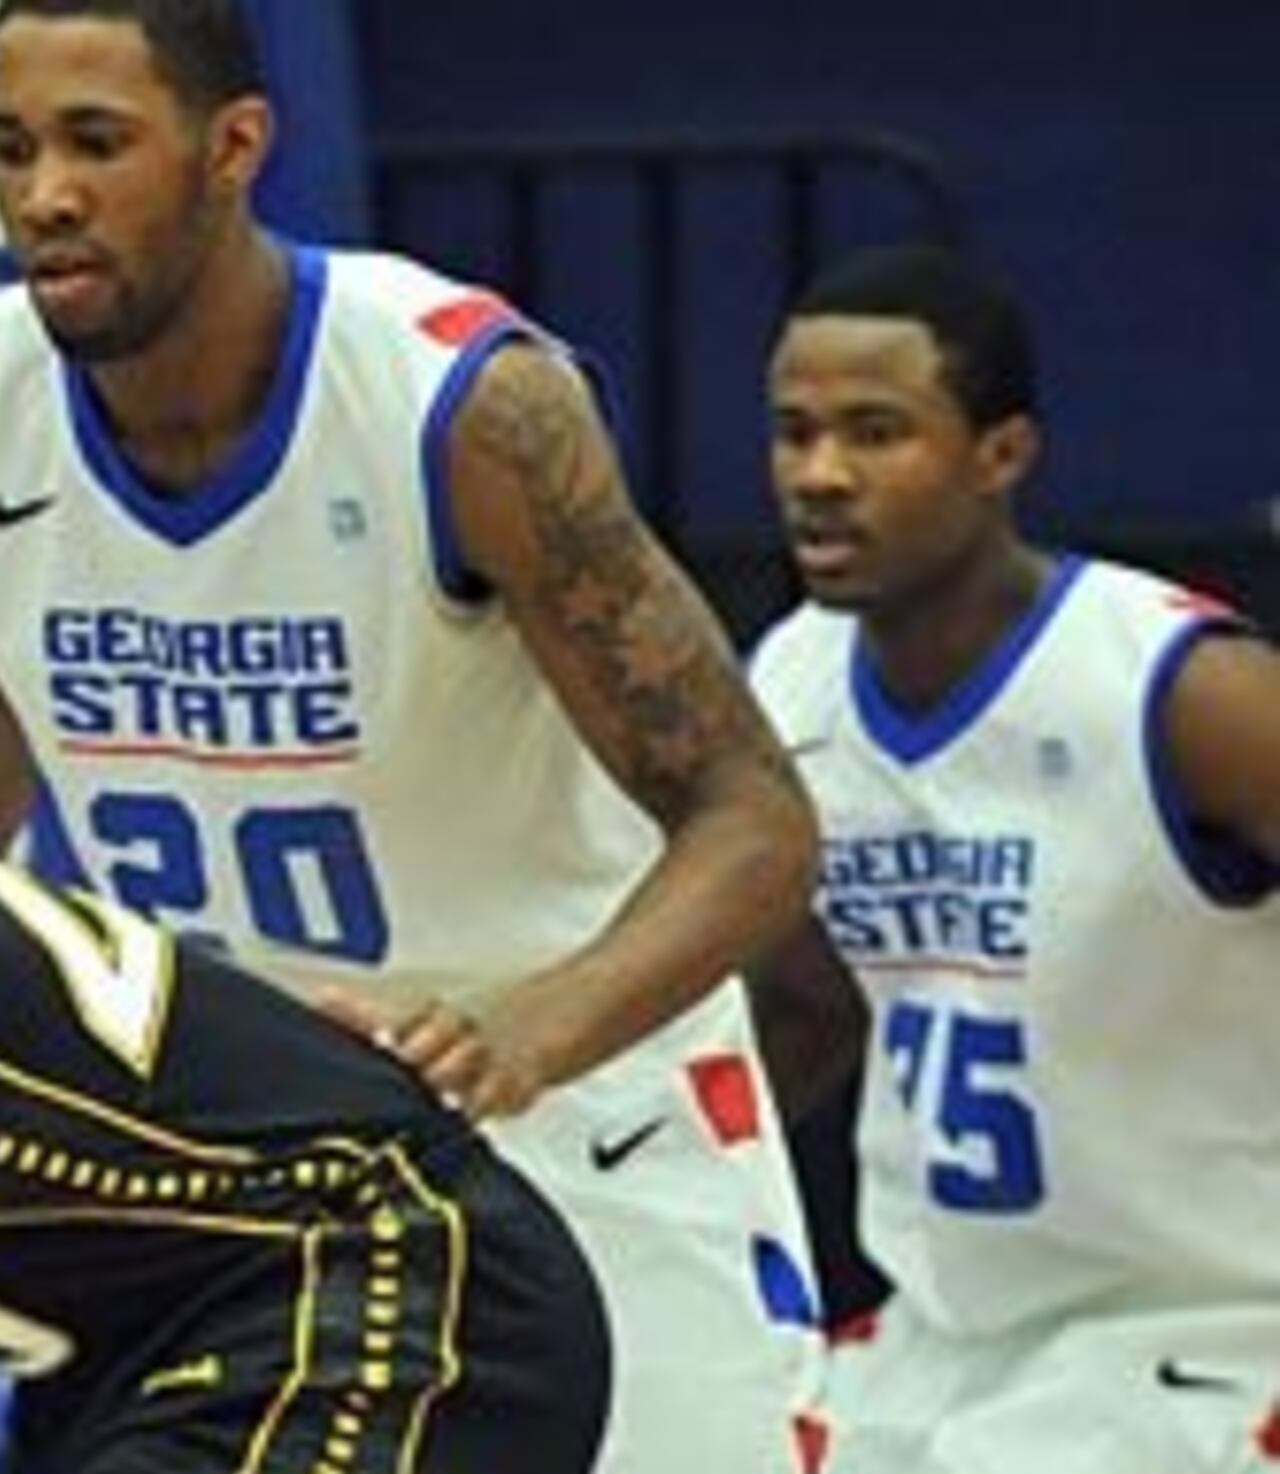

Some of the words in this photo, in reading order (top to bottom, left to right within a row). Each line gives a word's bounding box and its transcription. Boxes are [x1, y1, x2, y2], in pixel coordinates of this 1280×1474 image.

[43, 609, 347, 677] GEORGIA
[49, 672, 359, 747] STATE
[89, 793, 391, 968] 20
